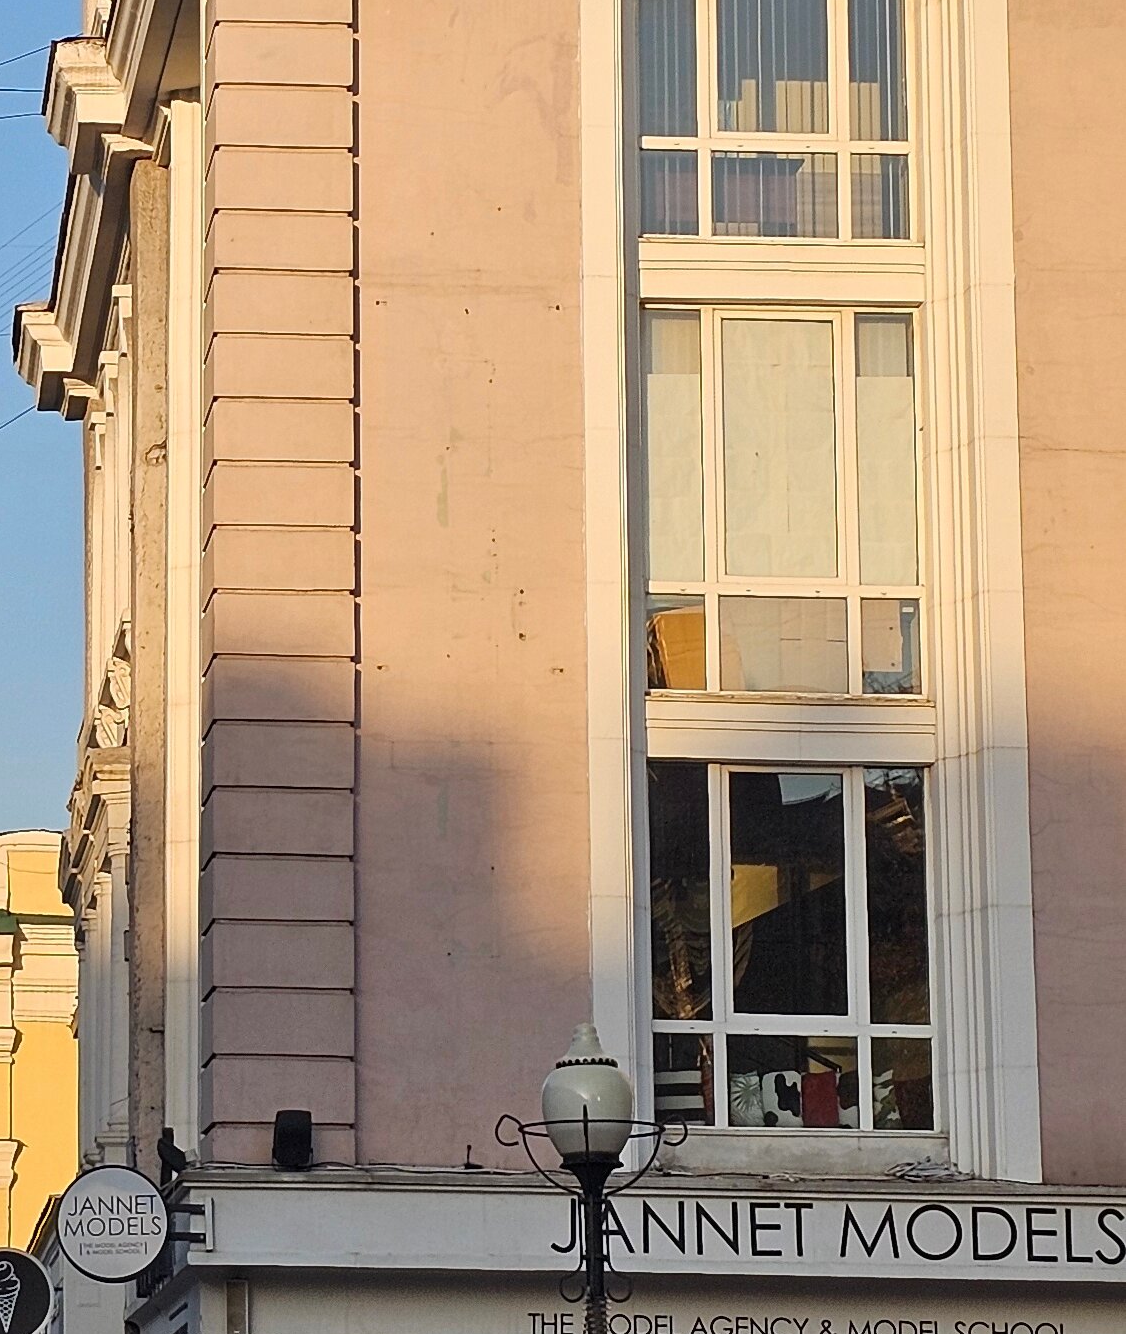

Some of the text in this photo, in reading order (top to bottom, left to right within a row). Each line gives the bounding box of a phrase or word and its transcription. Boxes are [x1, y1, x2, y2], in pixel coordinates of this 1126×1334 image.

[68, 1194, 157, 1216] JANNET
[64, 1216, 162, 1237] MODELS
[550, 1198, 1126, 1265] JANNET MODELS
